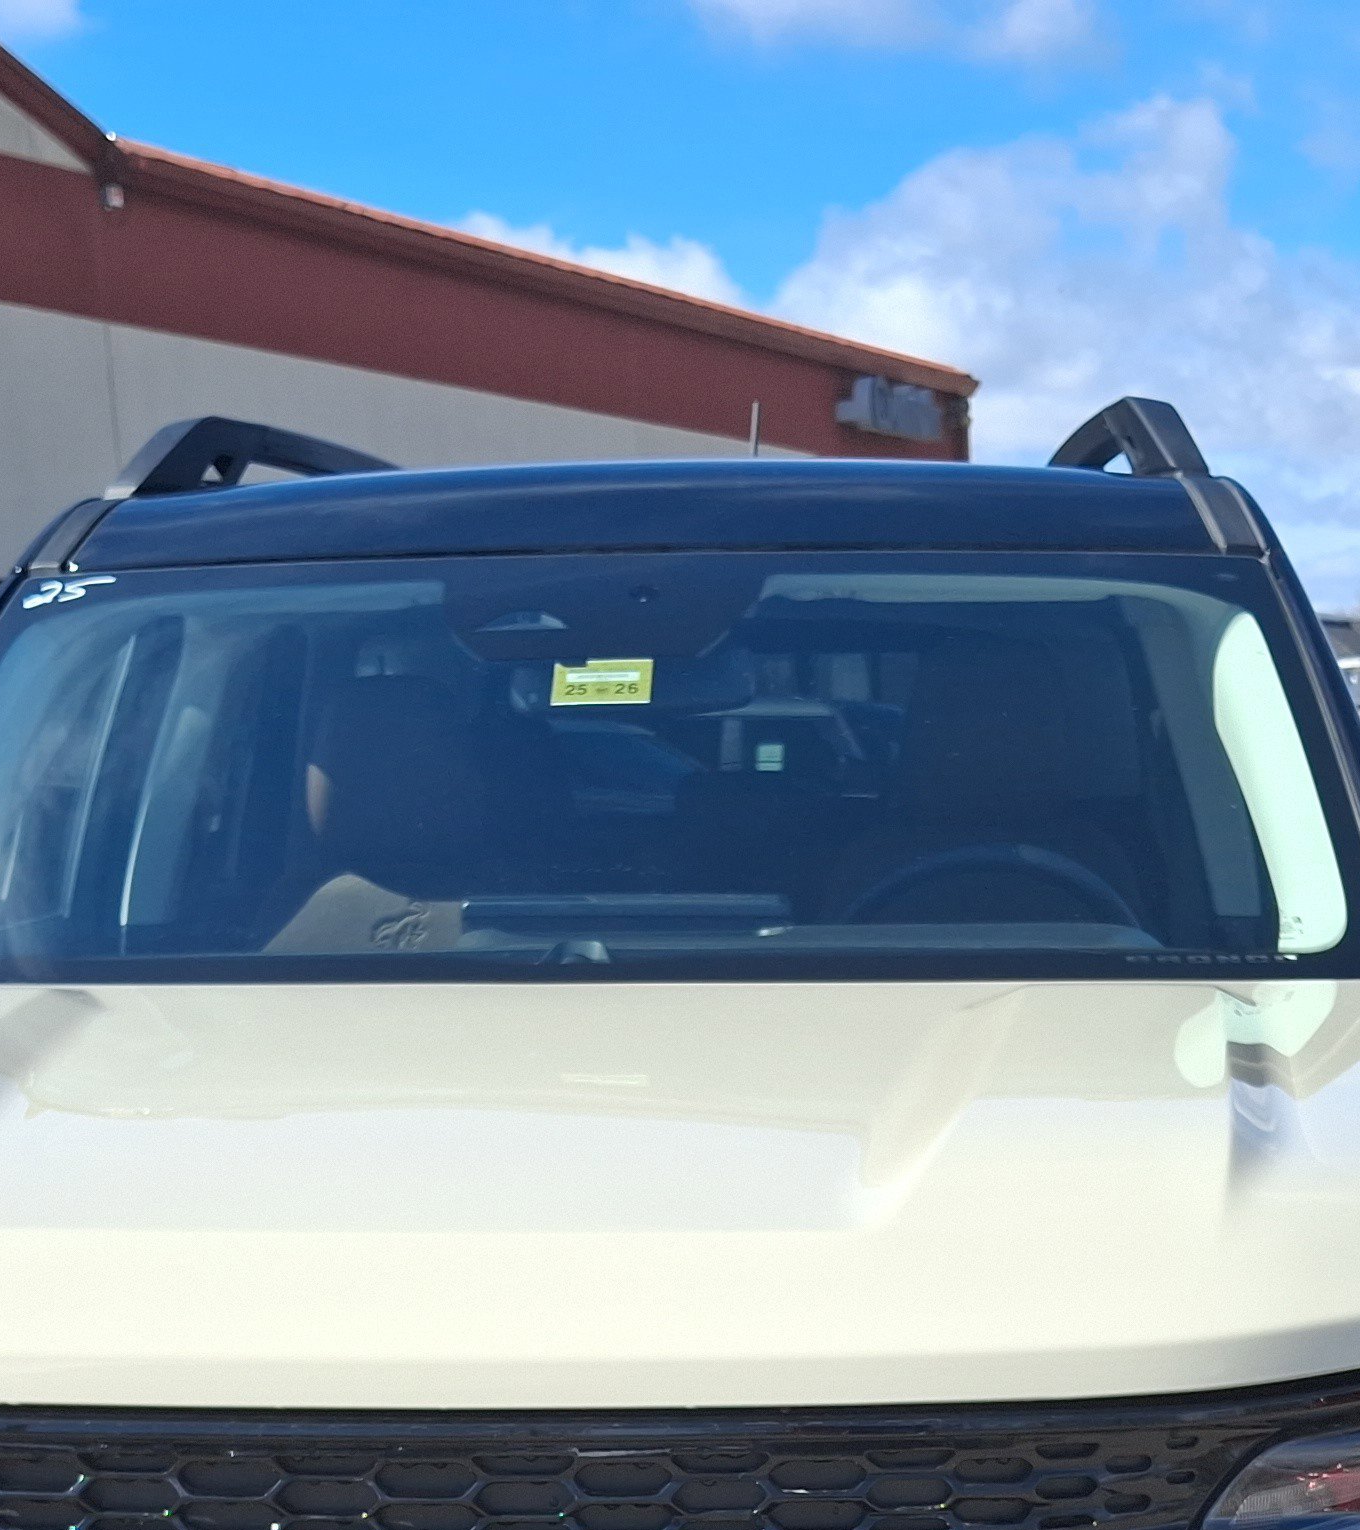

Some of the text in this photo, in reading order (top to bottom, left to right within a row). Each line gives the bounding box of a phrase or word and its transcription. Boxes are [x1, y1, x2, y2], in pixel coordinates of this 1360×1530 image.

[22, 575, 116, 609] 25
[565, 683, 588, 696] 25
[614, 682, 639, 695] 26
